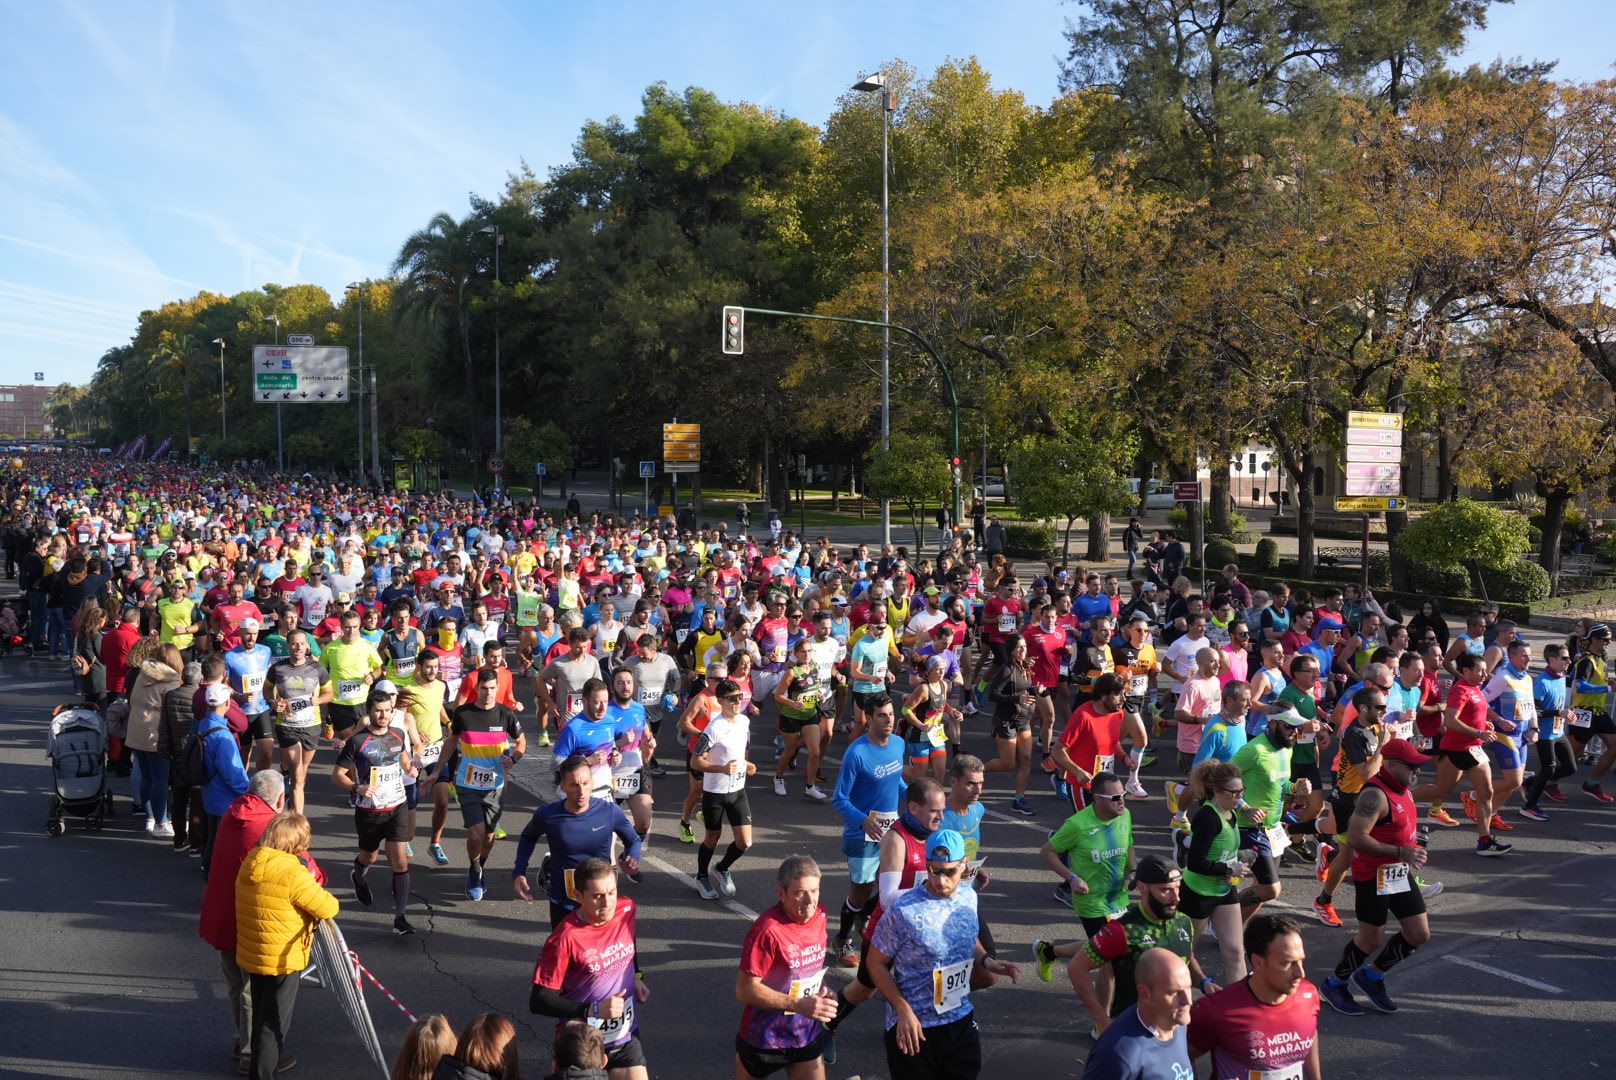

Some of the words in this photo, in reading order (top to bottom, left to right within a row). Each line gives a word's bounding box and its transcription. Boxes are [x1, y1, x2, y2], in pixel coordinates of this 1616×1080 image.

[260, 382, 294, 390] Aeropuerto
[490, 460, 502, 468] 50
[343, 684, 361, 692] 2813
[291, 700, 307, 711] 593
[424, 747, 440, 757] 253
[473, 771, 494, 782] 1193
[616, 778, 638, 788] 1778
[599, 942, 625, 960] MEDIA
[801, 943, 823, 957] MEDIA
[588, 961, 601, 973] 36
[789, 959, 801, 969] 36
[946, 969, 967, 990] 970
[599, 1007, 632, 1032] 4515
[1267, 1031, 1301, 1047] MEDIA
[1250, 1047, 1267, 1059] 36
